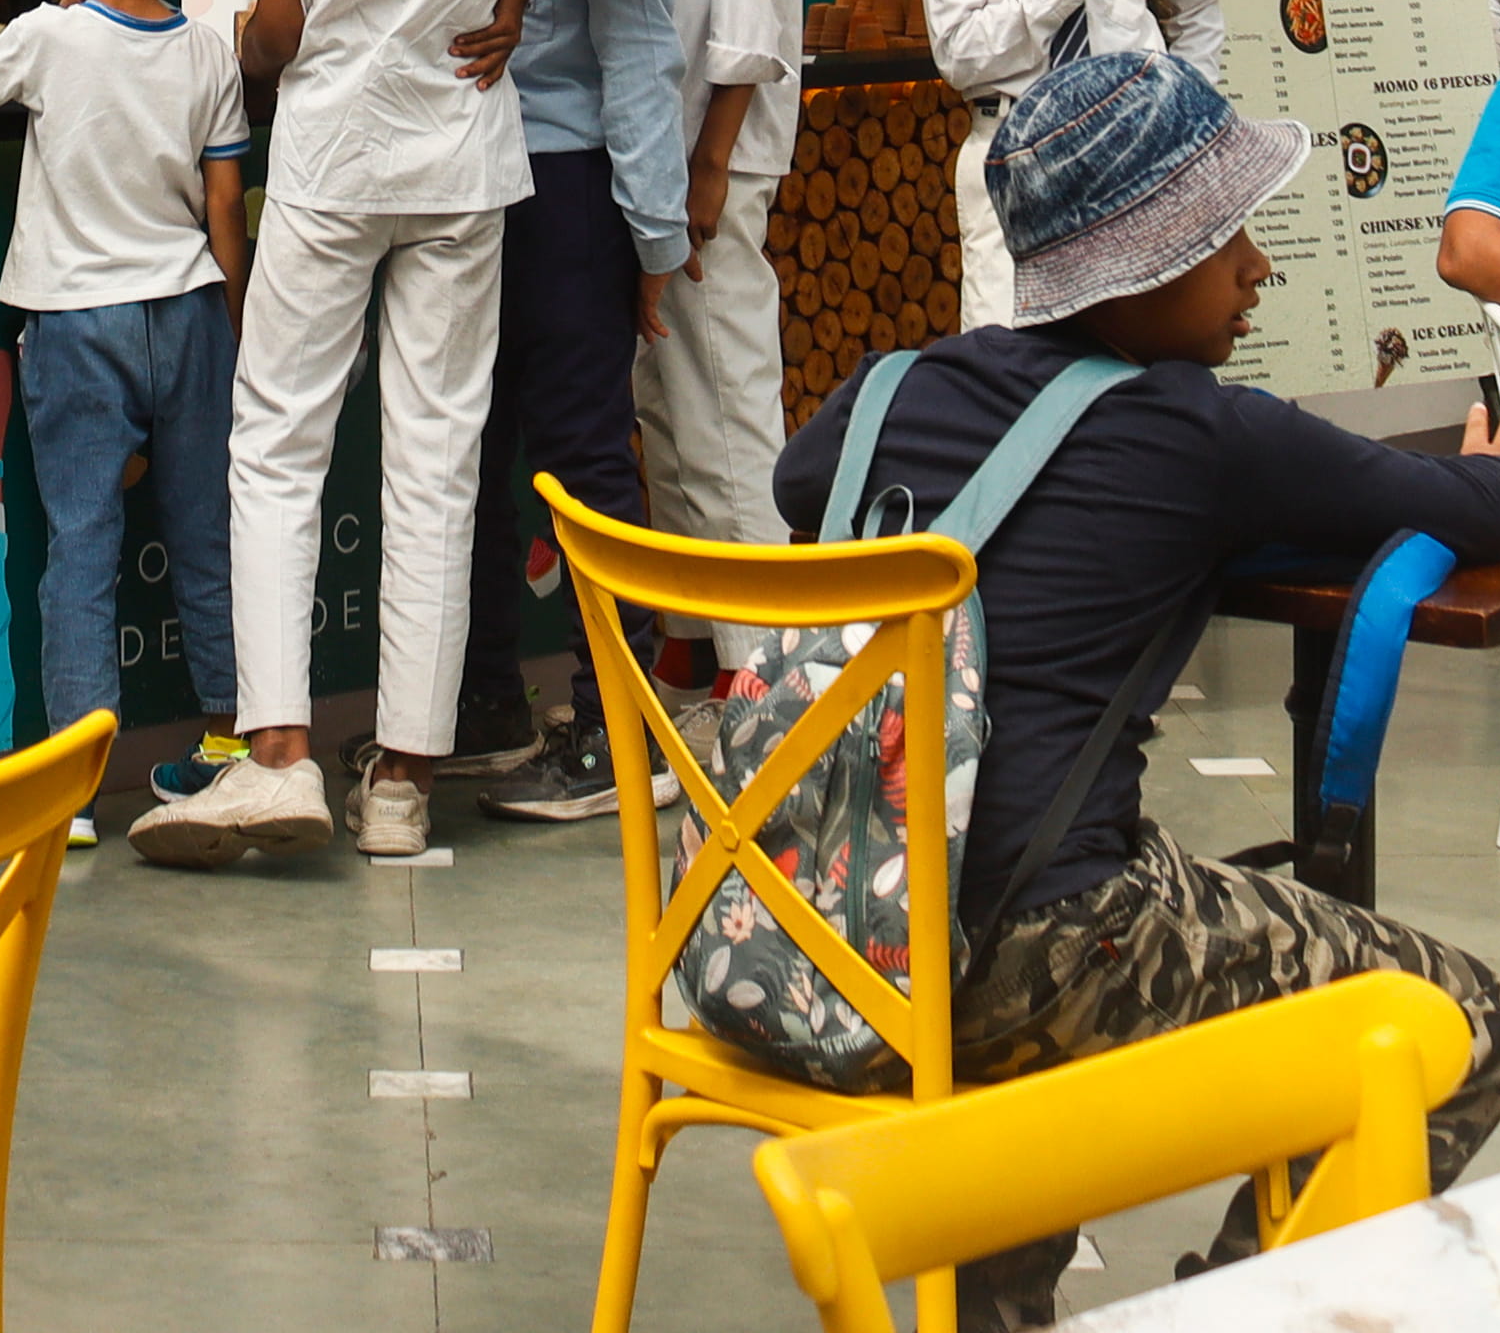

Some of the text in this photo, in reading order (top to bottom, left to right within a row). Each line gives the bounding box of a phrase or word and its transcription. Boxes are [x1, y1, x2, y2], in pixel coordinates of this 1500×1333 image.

[1373, 73, 1498, 94] MOMO (6 PIECES)
[1310, 131, 1338, 148] LES
[1360, 217, 1424, 235] CHINESE
[1411, 326, 1436, 342] ICE
